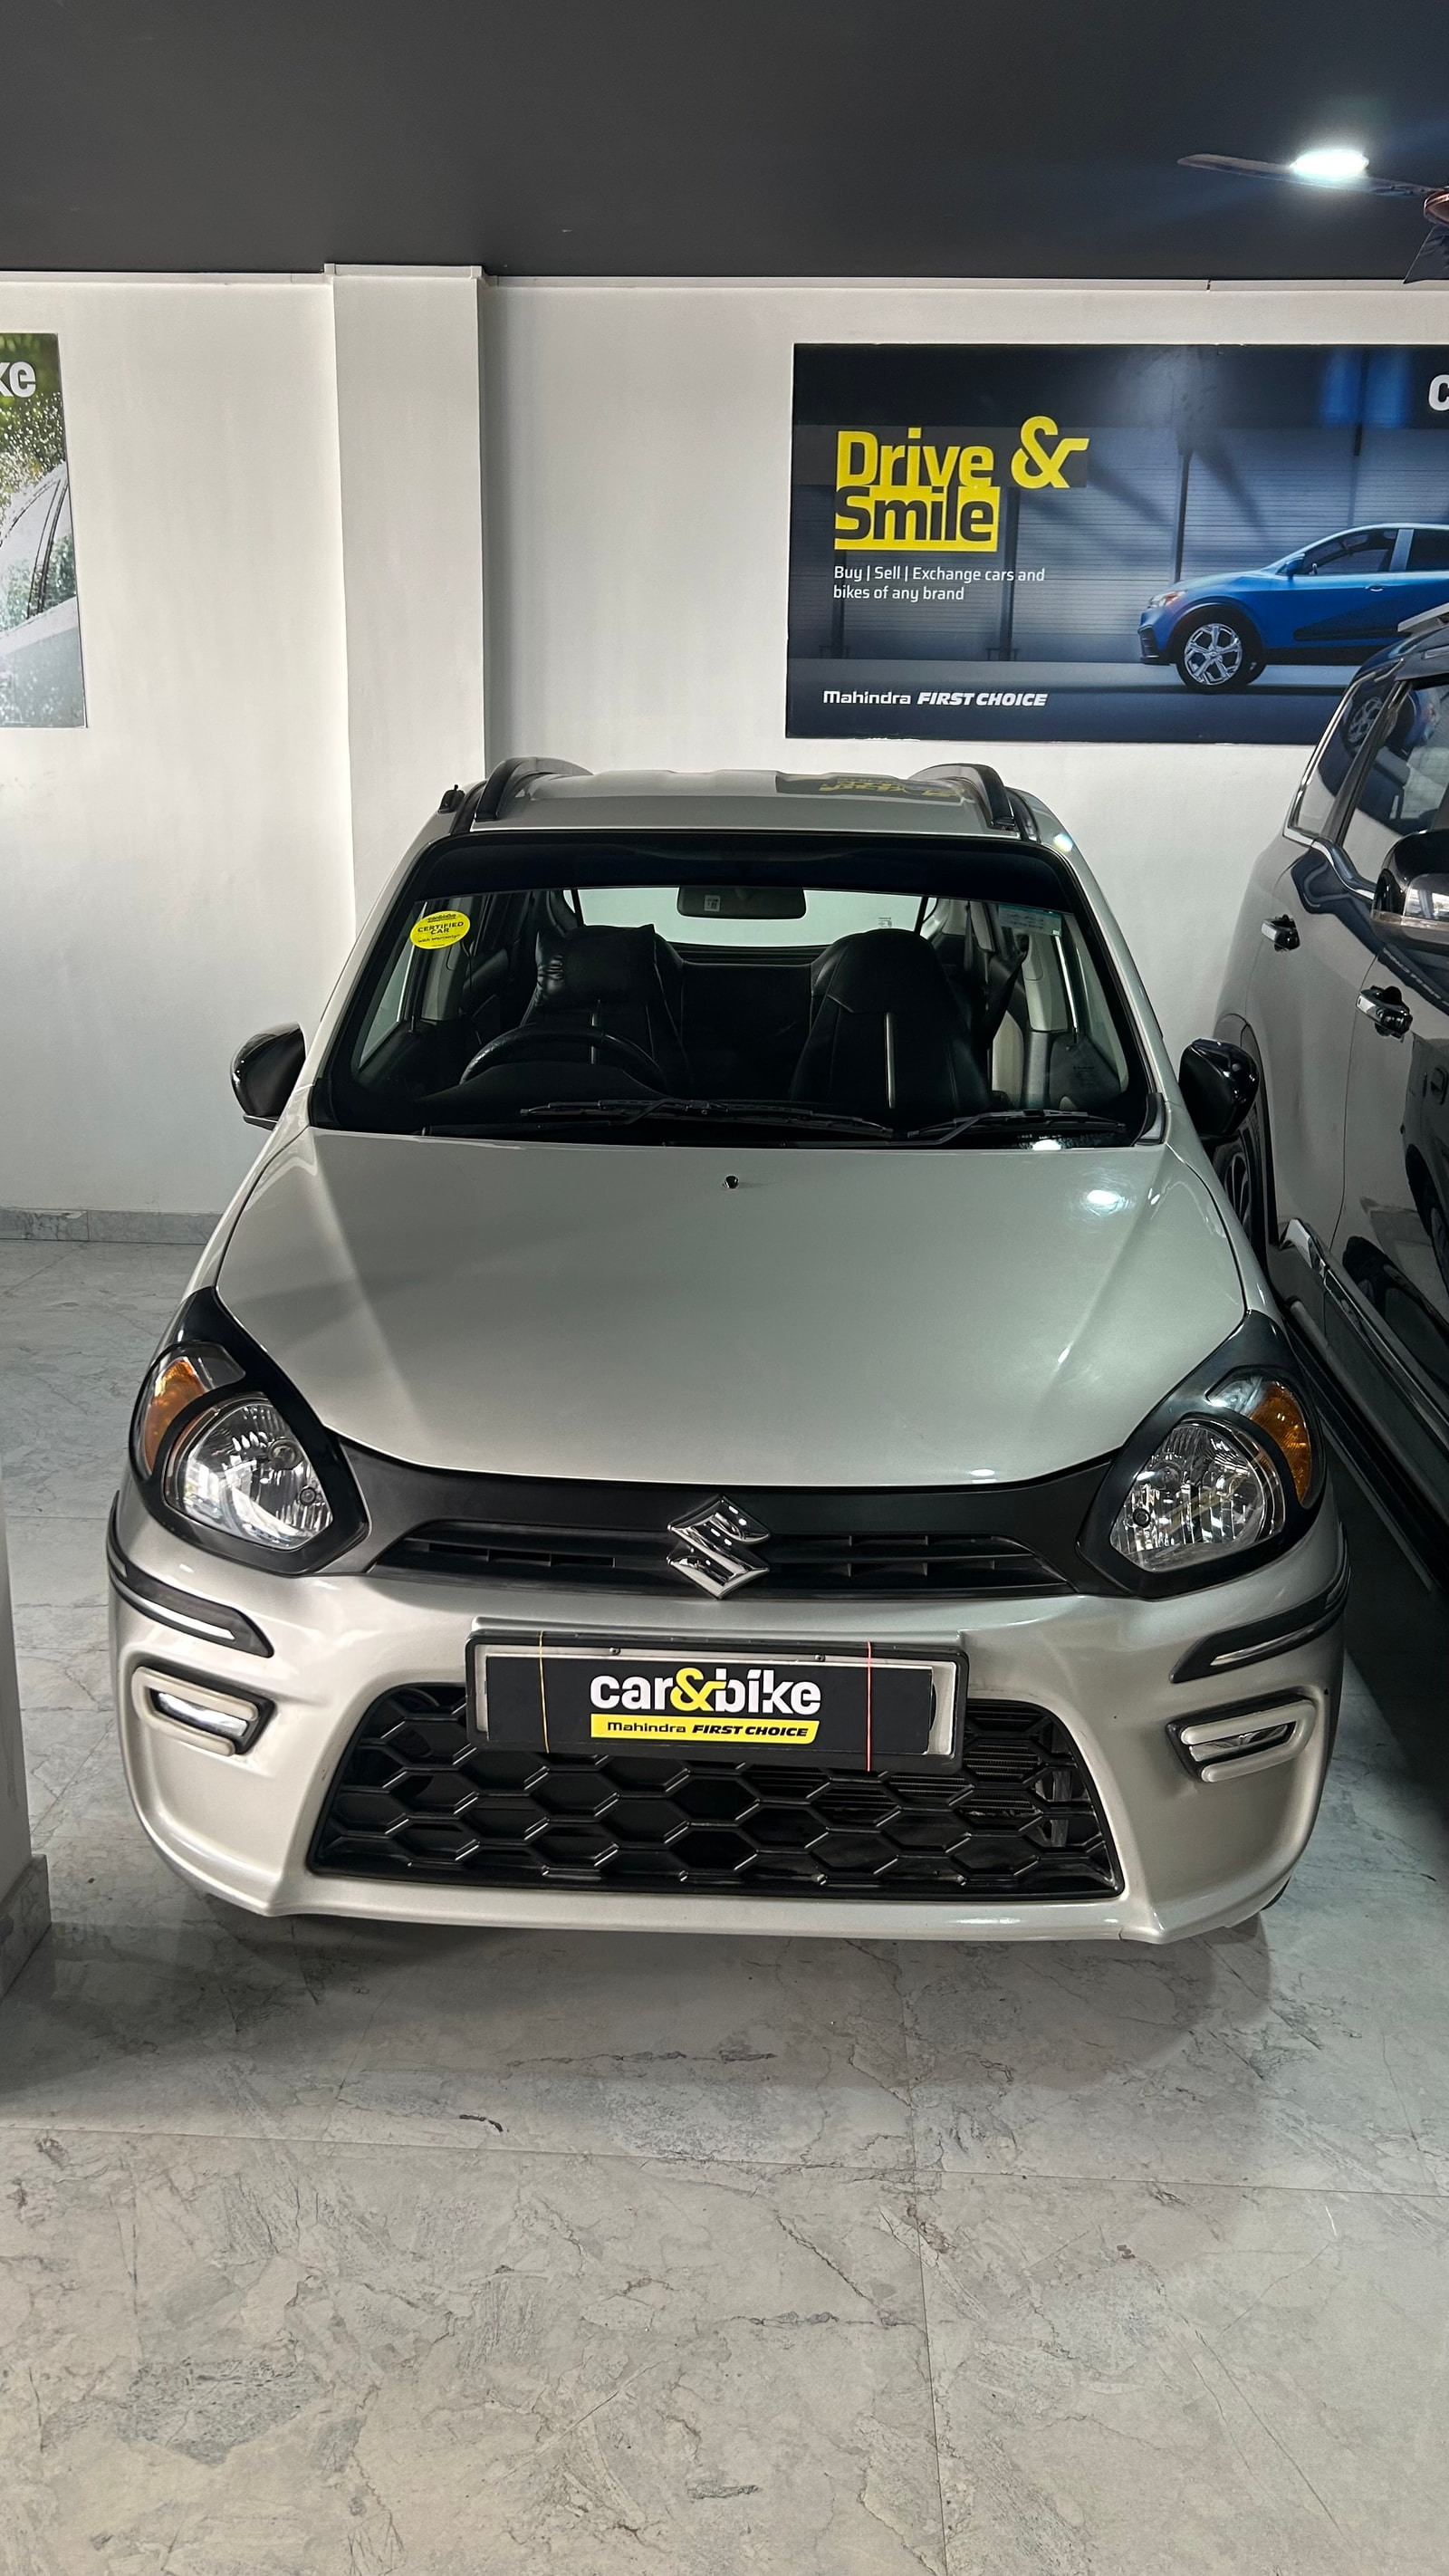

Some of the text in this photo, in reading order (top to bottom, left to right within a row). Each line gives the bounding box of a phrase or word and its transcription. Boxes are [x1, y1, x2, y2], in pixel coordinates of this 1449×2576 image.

[836, 415, 1090, 489] Drive &
[834, 485, 994, 542] Smile
[833, 565, 863, 582] Buy
[874, 566, 901, 580] Sell
[912, 566, 982, 583] Exchange
[984, 570, 1014, 582] cars
[1017, 568, 1045, 582] and
[833, 584, 965, 602] bikes of any brand
[822, 690, 1049, 706] Mahindra FIRST CHOICE
[417, 921, 464, 933] CERTIFIED
[590, 1667, 821, 1716] car&bike
[607, 1721, 810, 1737] Mahindra FIRST CHOICE
